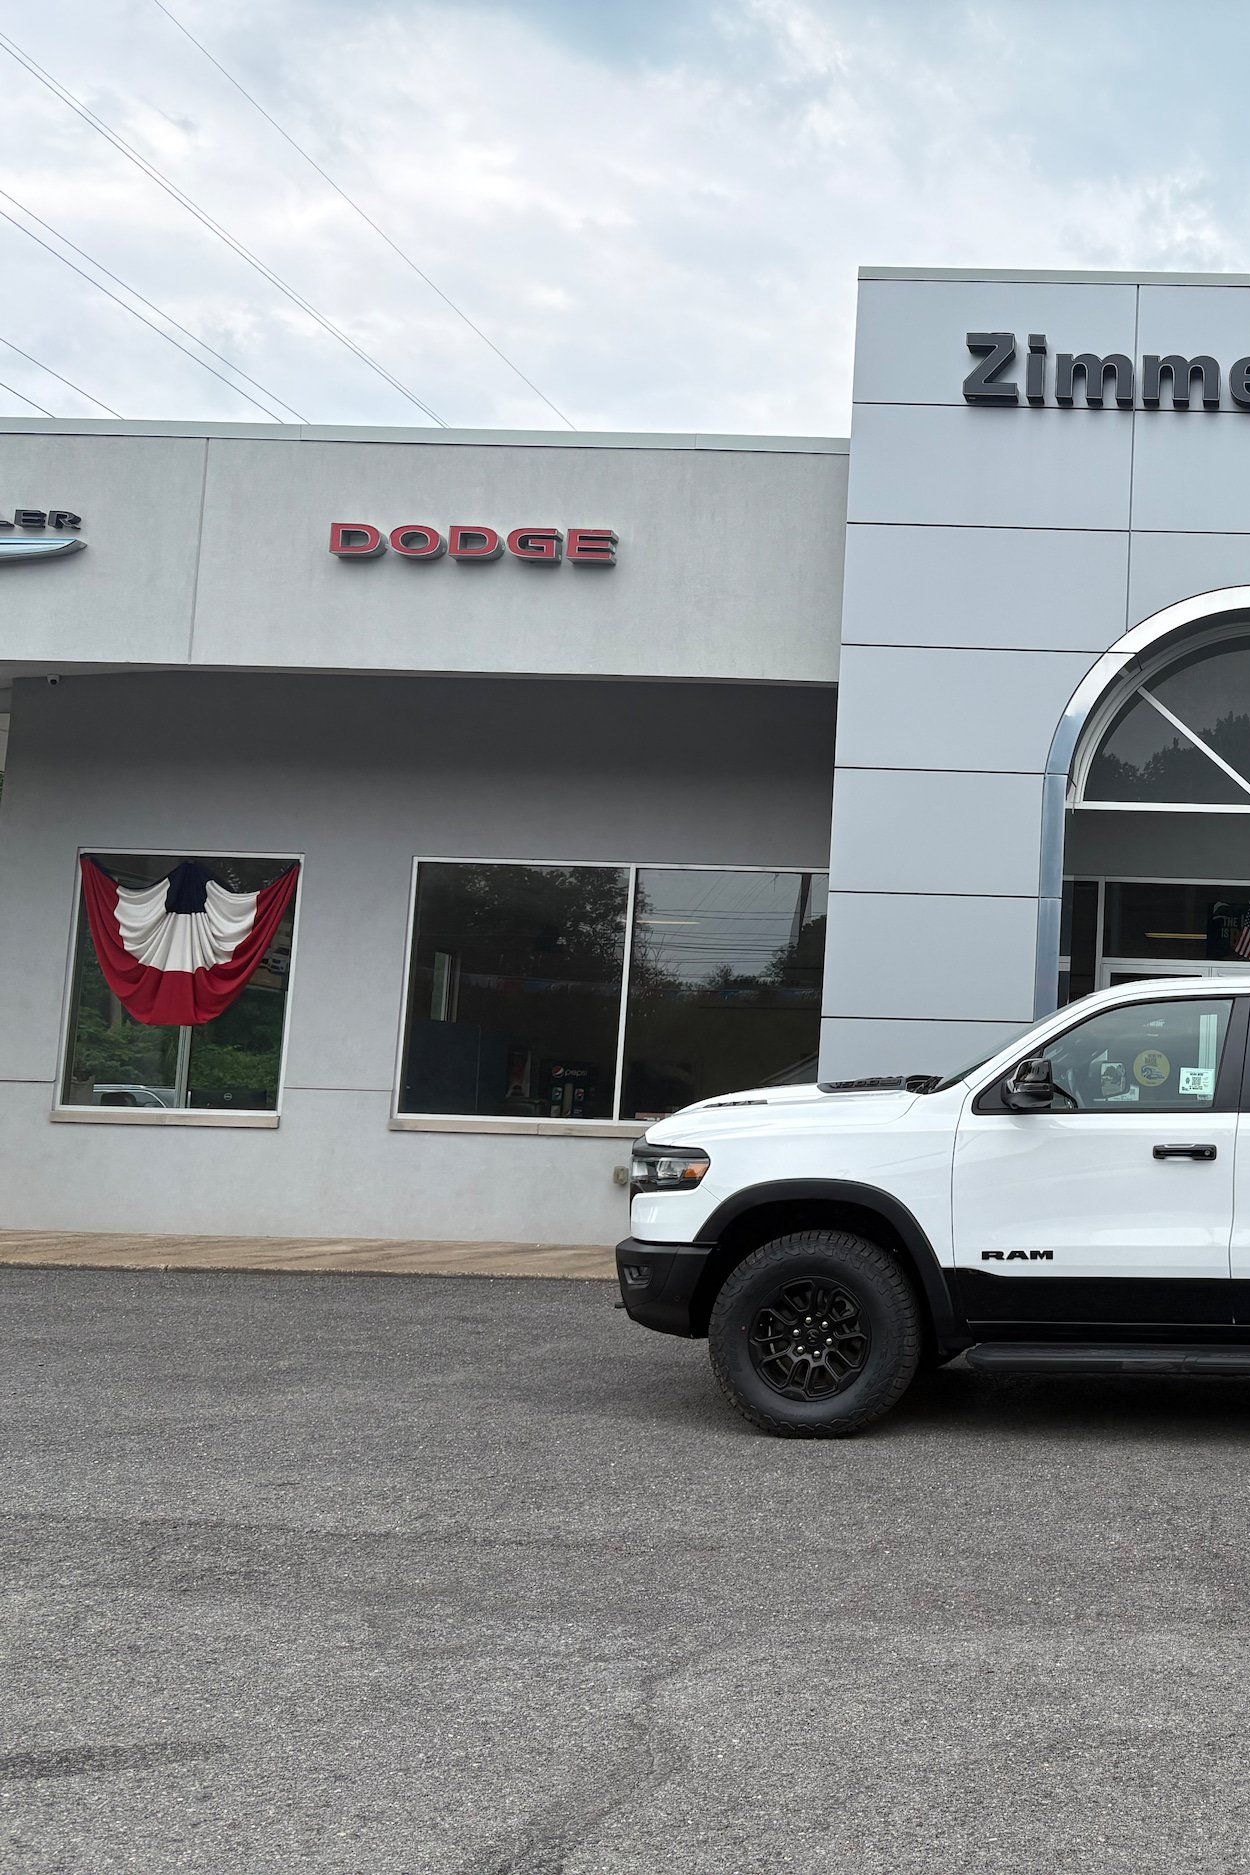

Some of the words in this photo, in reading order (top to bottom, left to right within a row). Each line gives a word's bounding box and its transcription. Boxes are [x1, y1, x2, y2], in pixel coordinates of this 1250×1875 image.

[329, 523, 619, 567] DODGE
[1223, 916, 1238, 927] THE
[564, 1069, 588, 1077] pepsi
[981, 1250, 1054, 1261] RAM
